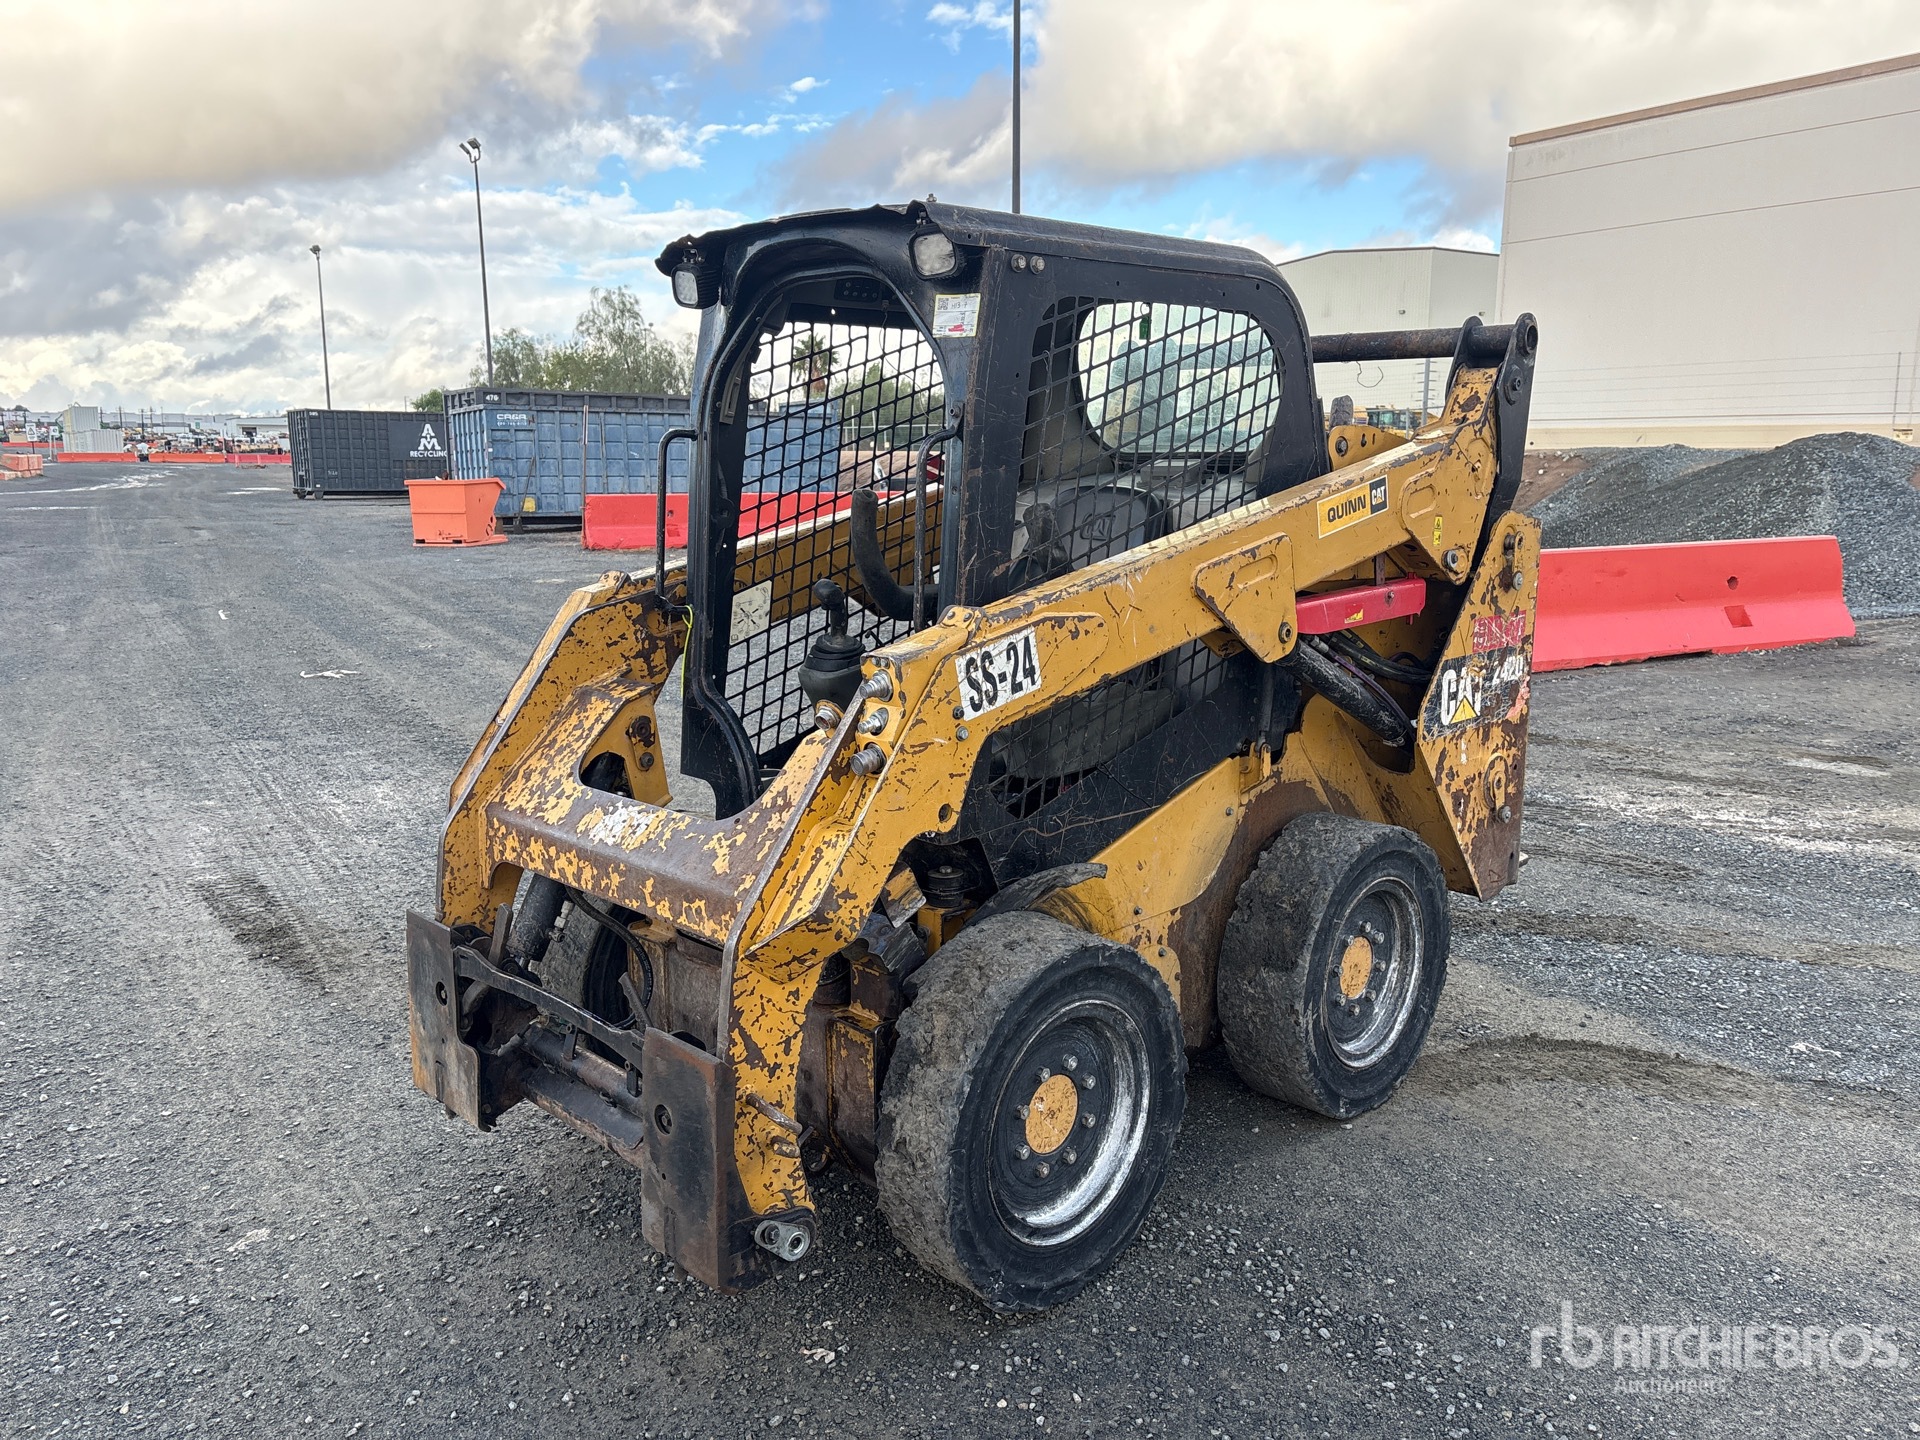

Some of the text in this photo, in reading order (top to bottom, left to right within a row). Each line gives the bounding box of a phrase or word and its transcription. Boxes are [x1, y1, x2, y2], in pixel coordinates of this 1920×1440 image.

[1327, 494, 1367, 523] QUINN
[1371, 485, 1386, 506] CAT
[965, 635, 1037, 713] SS-24
